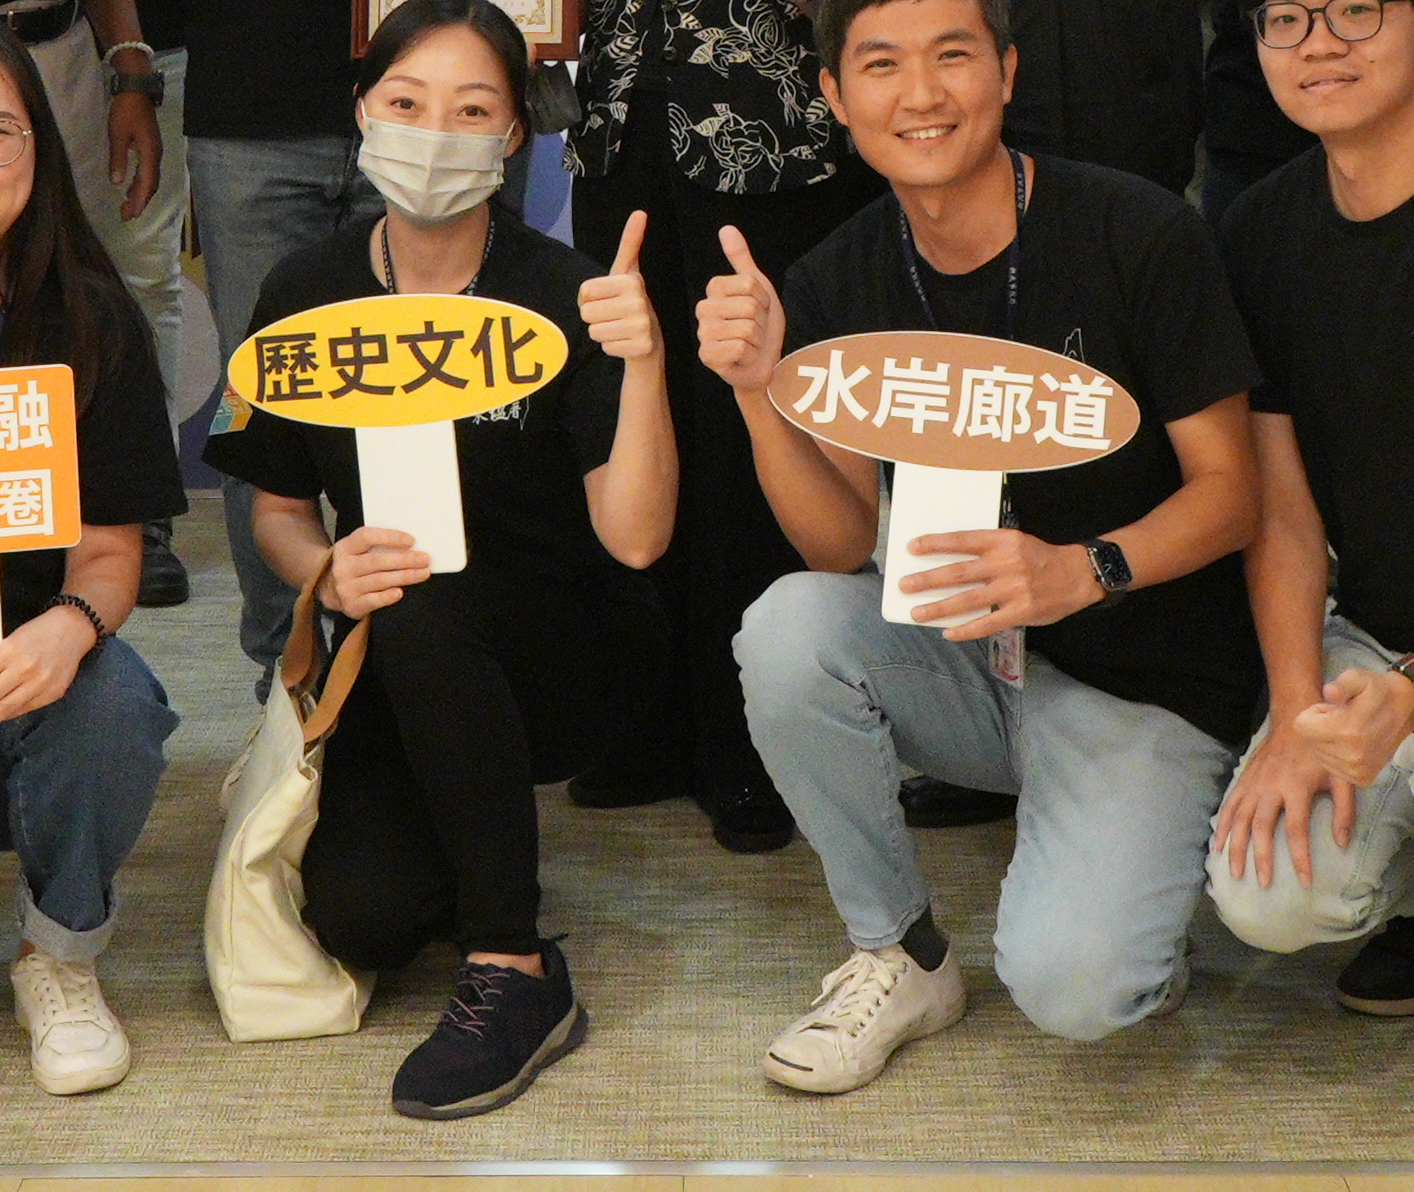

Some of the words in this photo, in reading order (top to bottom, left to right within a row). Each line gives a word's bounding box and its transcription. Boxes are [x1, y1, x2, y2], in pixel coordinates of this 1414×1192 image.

[254, 316, 544, 404] 歷史文化
[793, 349, 1114, 450] 水岸廊道
